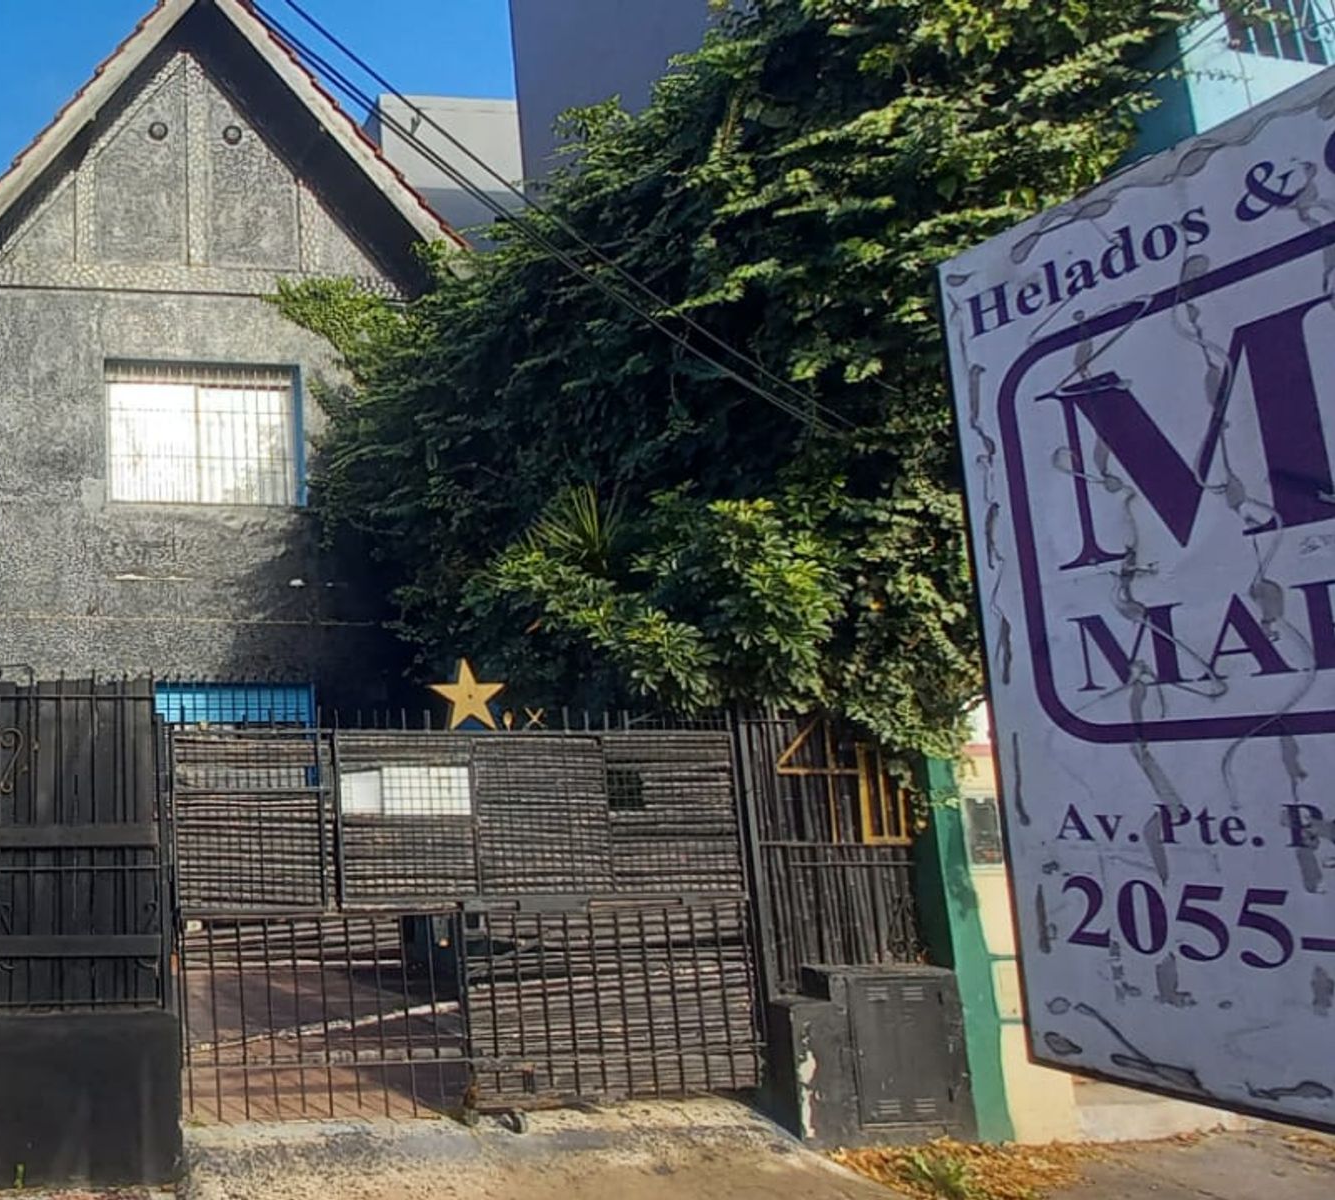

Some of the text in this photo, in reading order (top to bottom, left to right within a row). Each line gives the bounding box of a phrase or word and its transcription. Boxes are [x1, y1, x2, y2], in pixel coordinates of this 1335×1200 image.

[969, 161, 1305, 338] Helados &
[1057, 803, 1335, 848] Av. Pte. P
